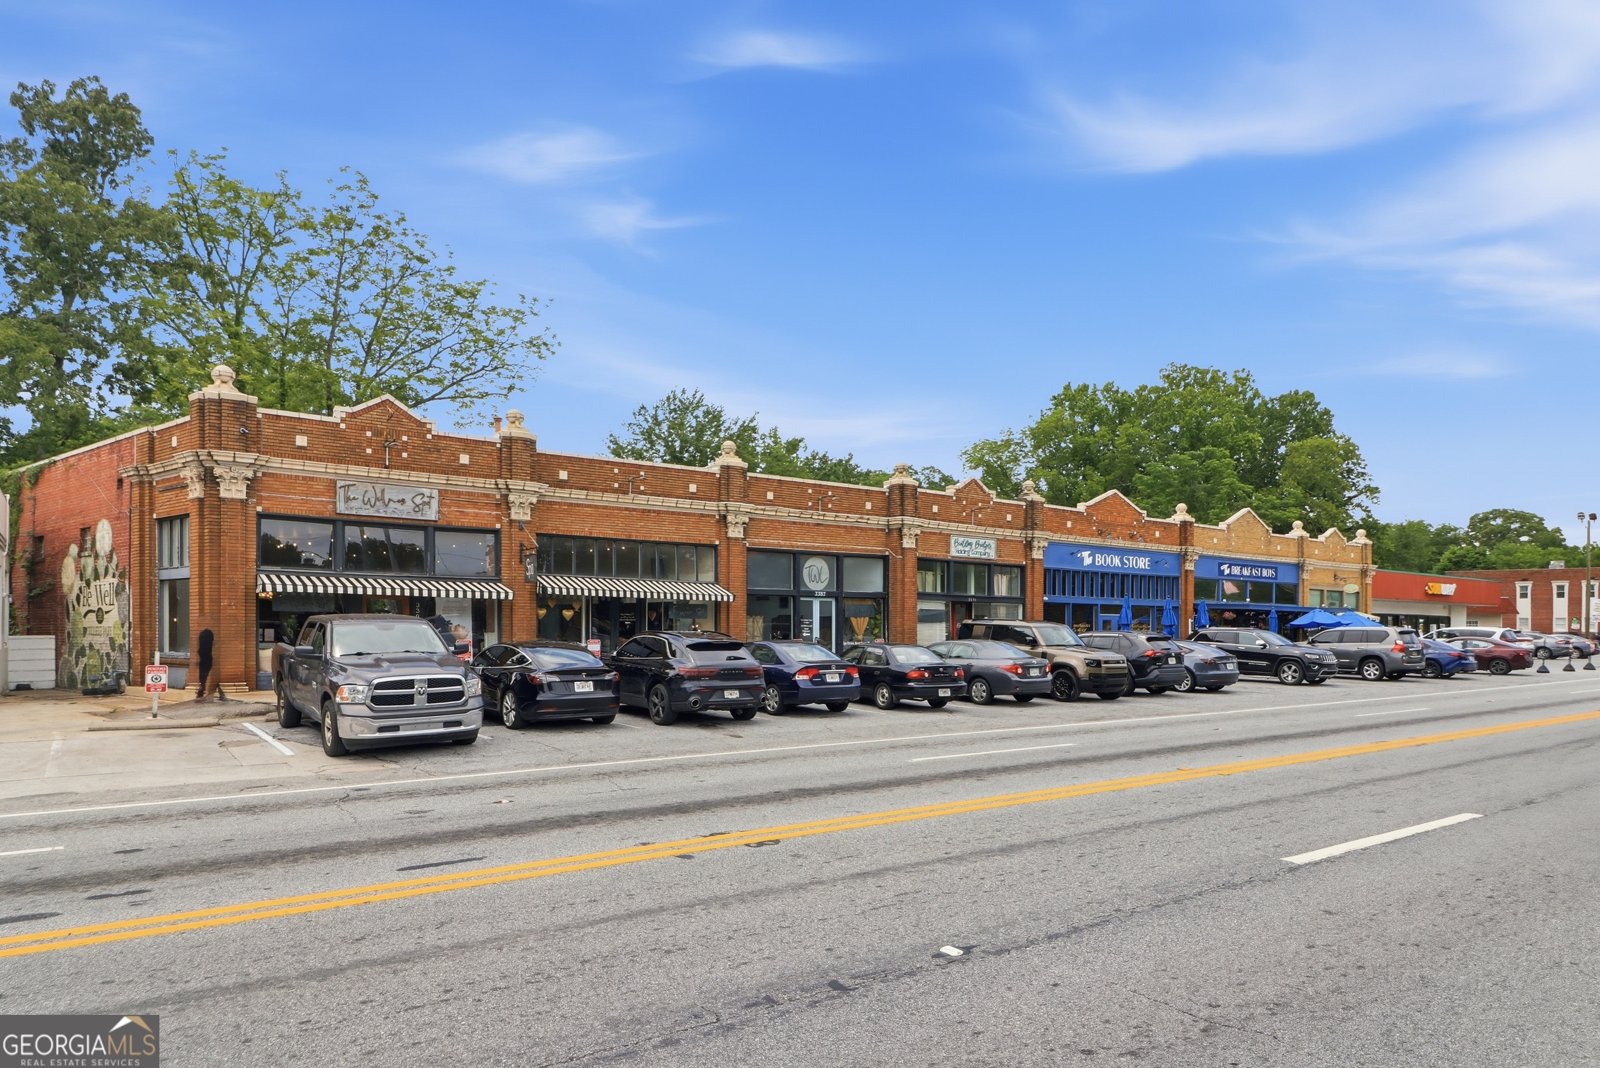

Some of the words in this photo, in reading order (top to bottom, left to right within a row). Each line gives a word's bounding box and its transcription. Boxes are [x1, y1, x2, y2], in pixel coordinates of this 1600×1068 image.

[338, 484, 359, 504] The
[411, 493, 435, 516] Spot
[1095, 553, 1121, 567] BOOK
[1123, 555, 1151, 569] STORE
[1231, 565, 1261, 577] BREAKFAST
[1262, 567, 1276, 578] BOYS
[94, 582, 115, 607] Well
